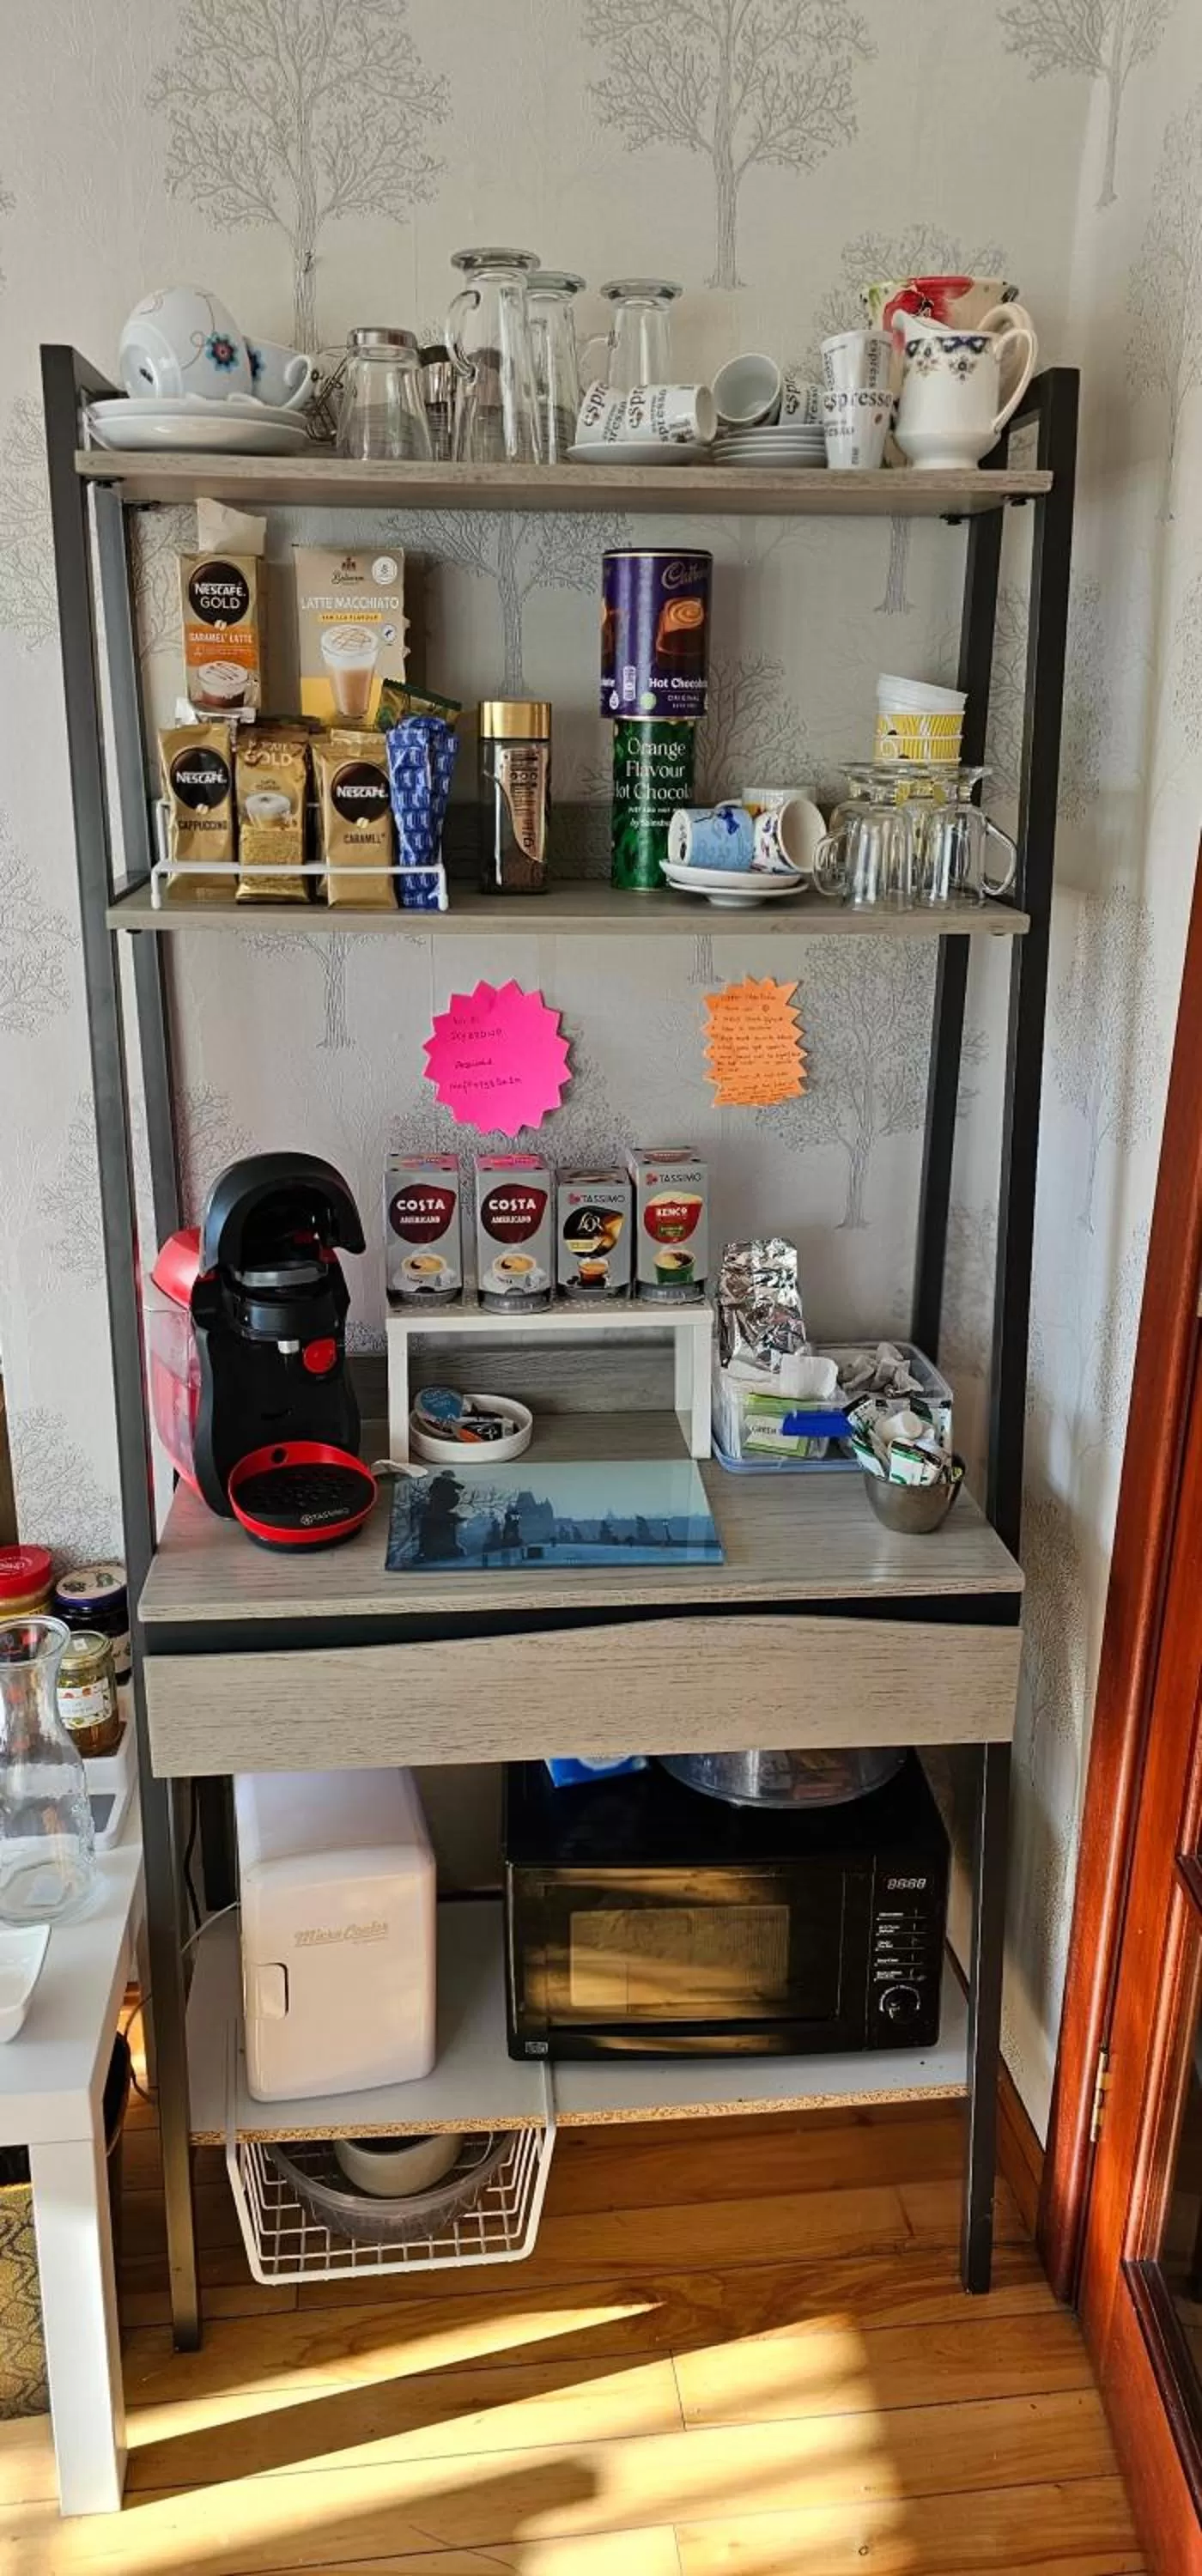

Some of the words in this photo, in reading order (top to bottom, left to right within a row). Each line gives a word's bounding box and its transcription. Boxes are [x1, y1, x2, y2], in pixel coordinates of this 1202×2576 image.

[200, 596, 241, 610] GOLD
[301, 597, 333, 610] LATTE
[334, 597, 400, 610] MACCHIATO
[648, 677, 668, 689] Hot
[628, 737, 687, 762] Orange
[244, 750, 294, 767] GOLD
[626, 760, 686, 779] Flavour
[659, 1172, 702, 1183] TASSIMO
[396, 1199, 446, 1211] COSTA
[488, 1199, 537, 1211] COSTA
[581, 1194, 626, 1204] TASSIMO
[655, 1206, 688, 1217] KENCO
[399, 1215, 440, 1224] AMERICANO
[490, 1215, 531, 1224] AMERICANO
